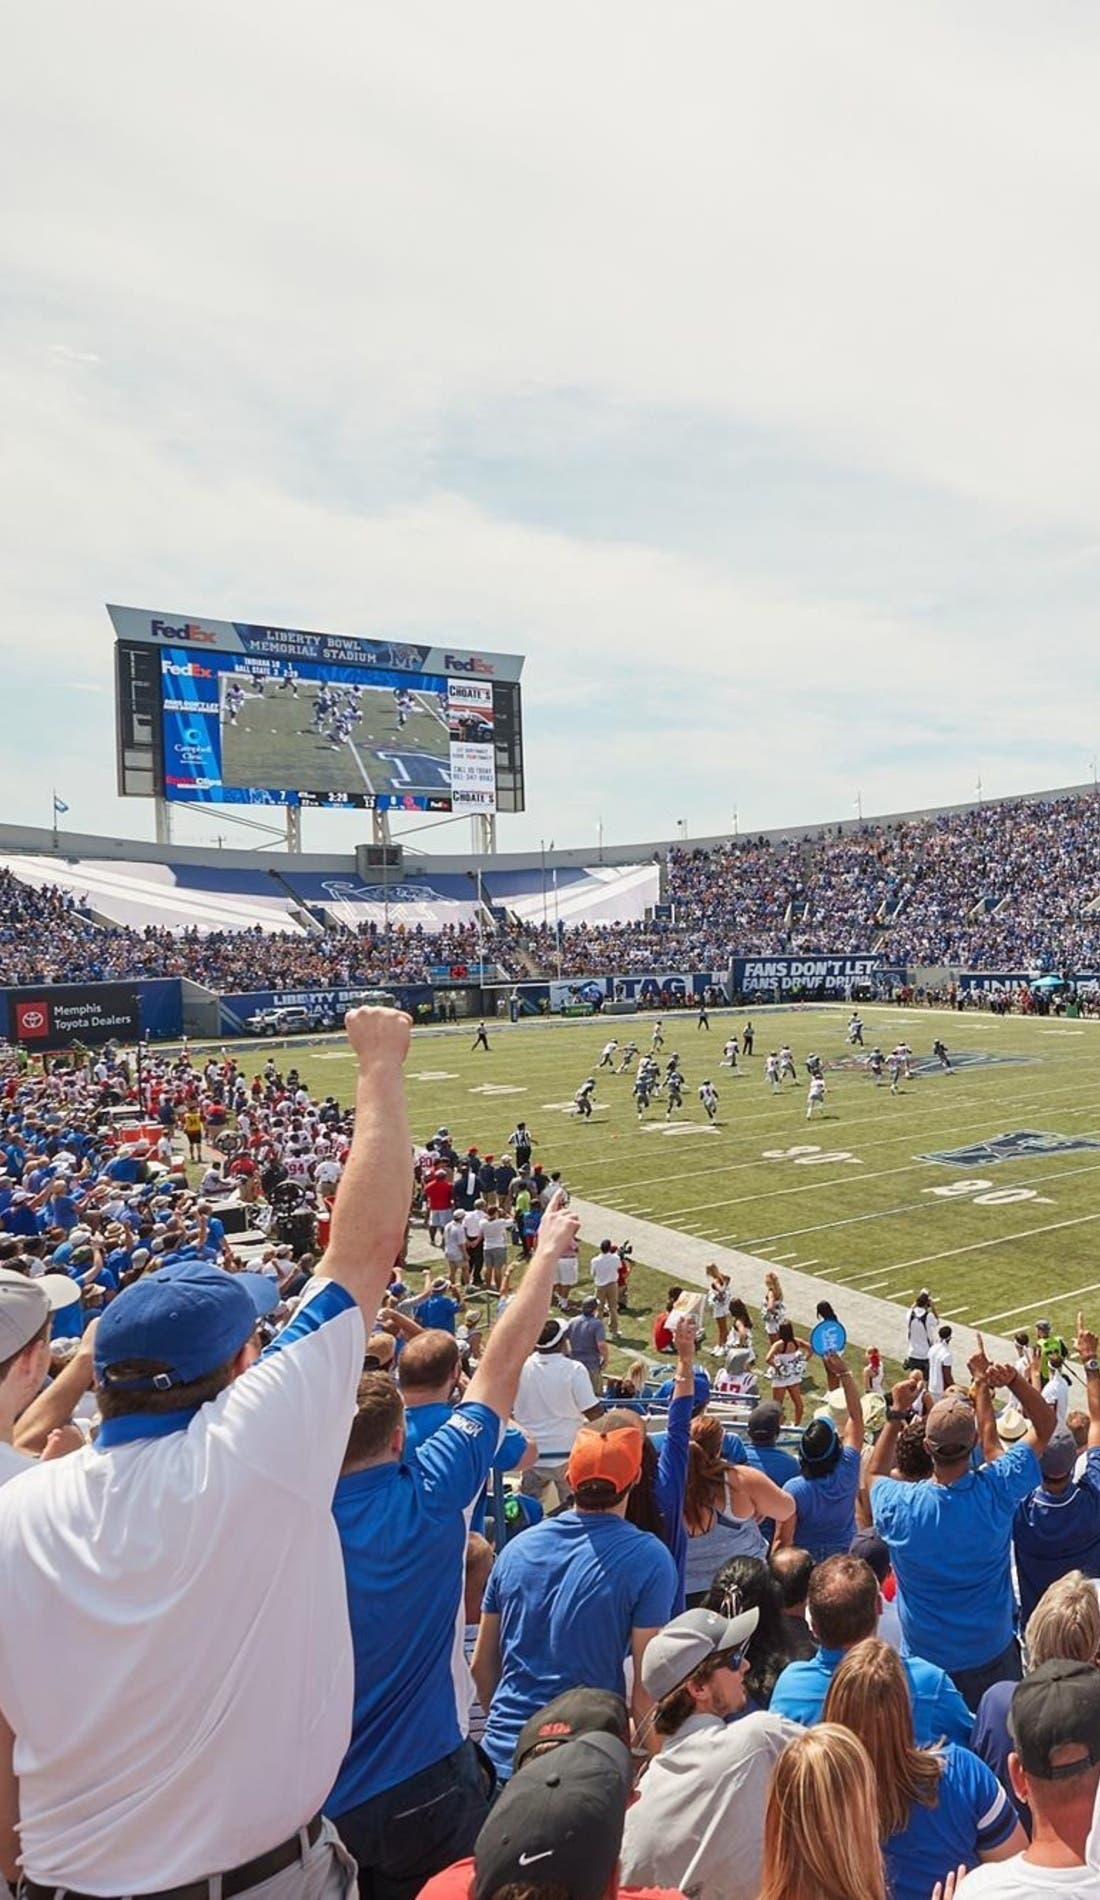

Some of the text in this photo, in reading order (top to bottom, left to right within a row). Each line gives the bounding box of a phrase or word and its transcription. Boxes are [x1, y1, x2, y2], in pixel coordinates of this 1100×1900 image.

[151, 620, 218, 643] FedEx
[266, 630, 361, 651] LIBERTY BOWL
[250, 640, 377, 664] MEMORIAL STADIUM
[162, 660, 212, 678] FedEx
[444, 655, 495, 674] FedEx
[451, 965, 466, 979] 25
[744, 960, 875, 977] FANS DON'T LET
[619, 977, 686, 1000] TAG
[743, 977, 779, 992] FANS
[54, 1003, 101, 1016] Memphis
[54, 1015, 131, 1031] Toyota Dealers
